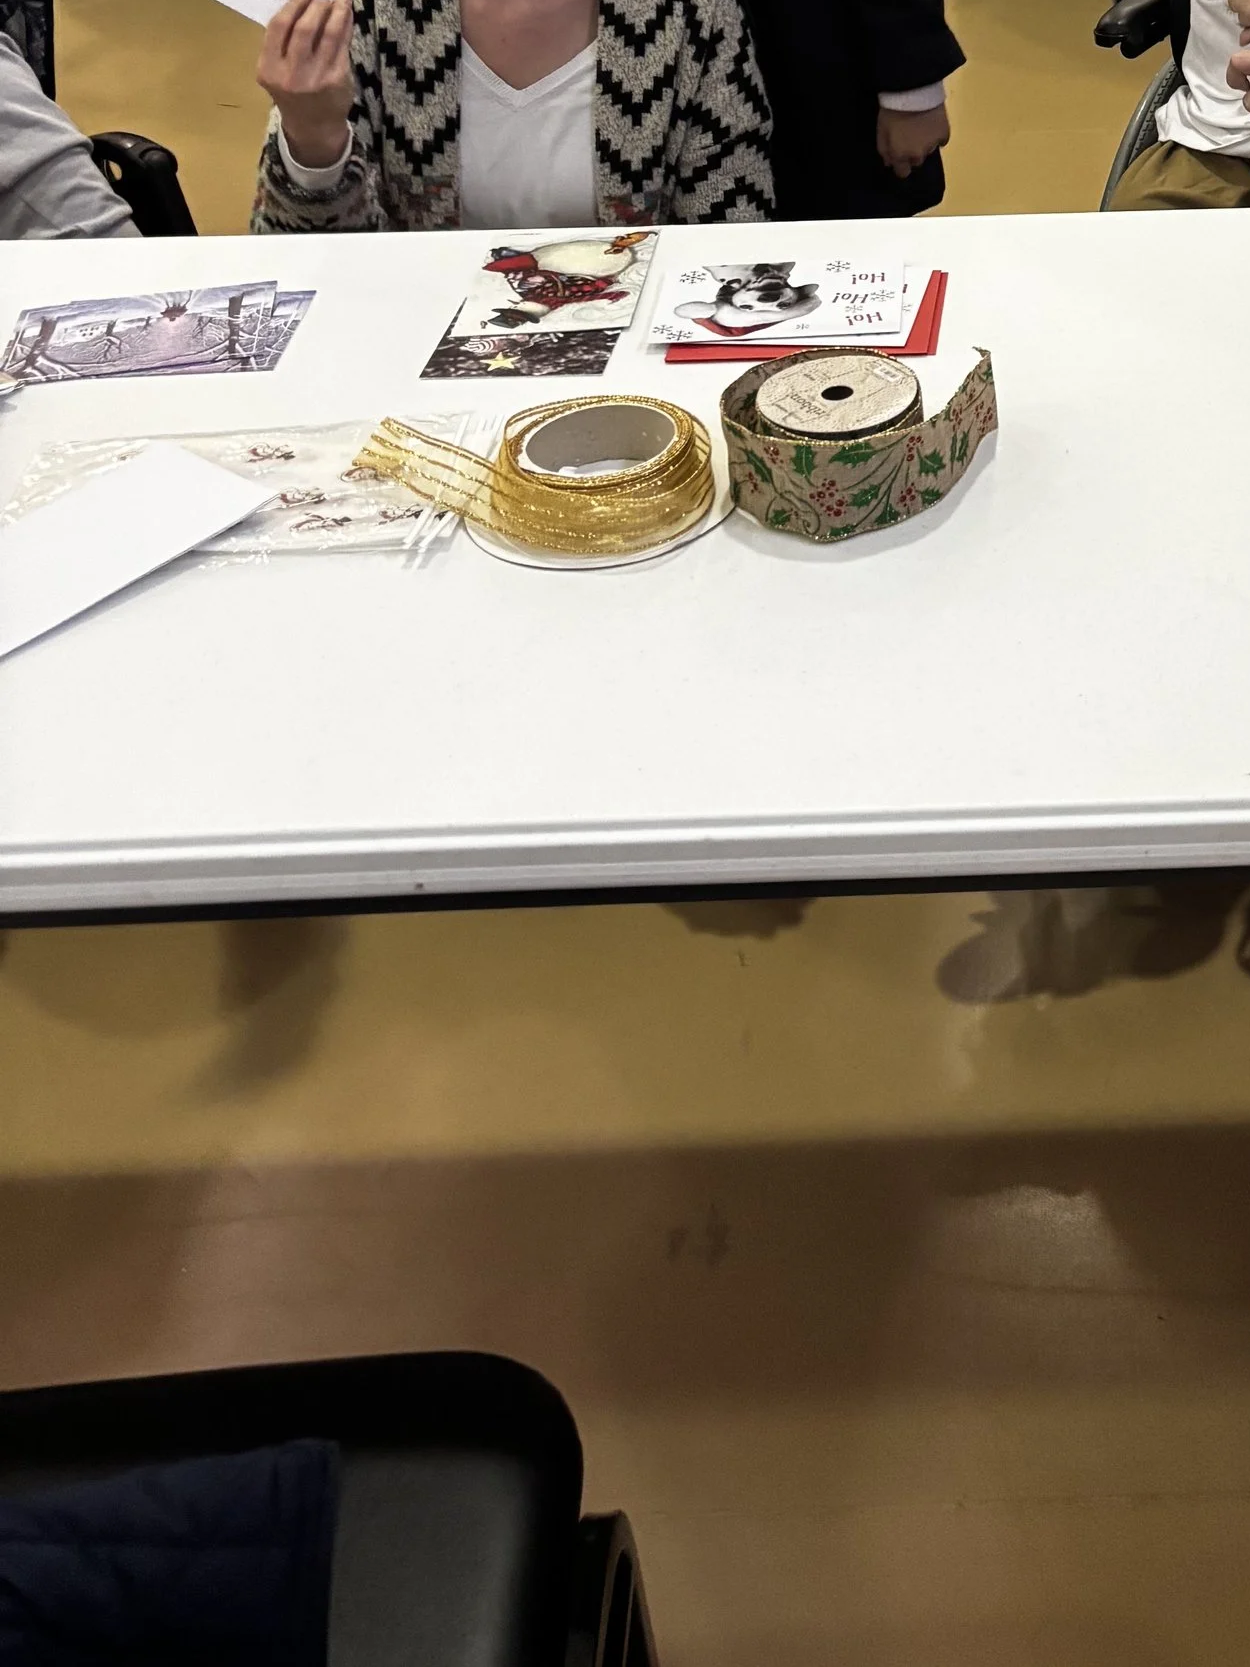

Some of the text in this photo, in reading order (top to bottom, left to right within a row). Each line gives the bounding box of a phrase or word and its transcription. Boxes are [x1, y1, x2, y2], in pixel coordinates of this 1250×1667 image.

[852, 272, 885, 285] Ho!
[832, 292, 869, 304] Ho!
[845, 312, 882, 326] Ho!
